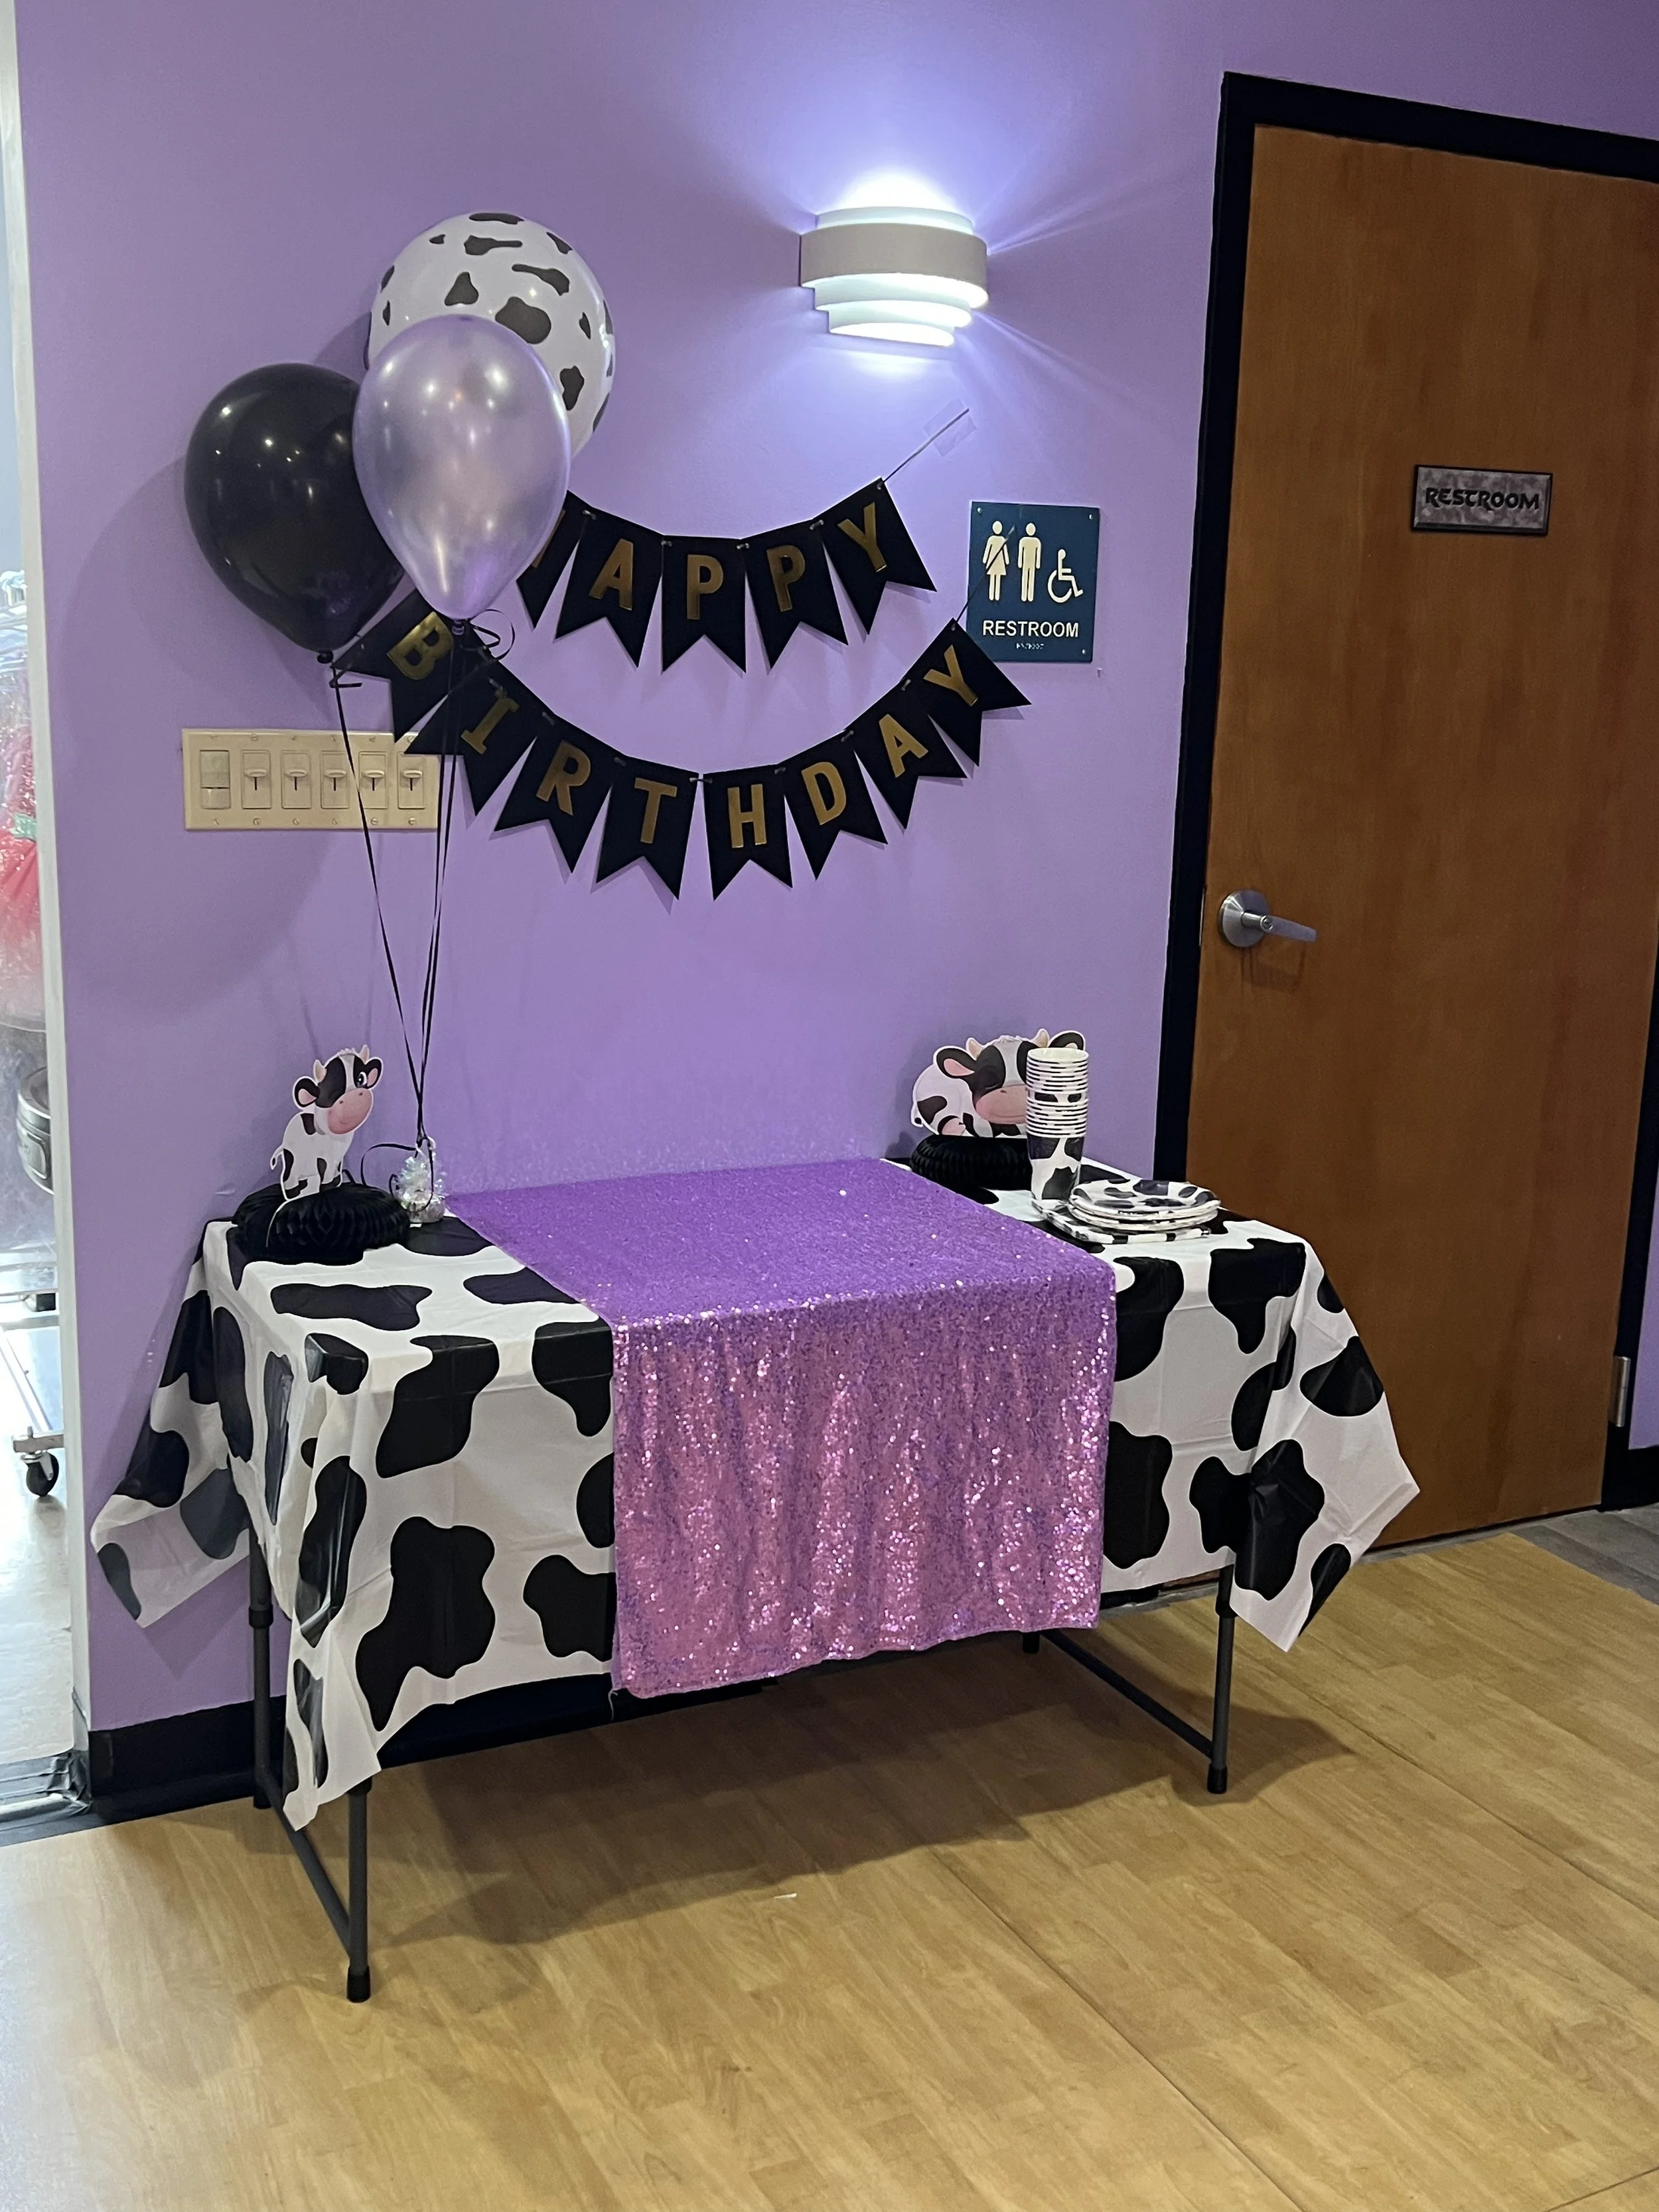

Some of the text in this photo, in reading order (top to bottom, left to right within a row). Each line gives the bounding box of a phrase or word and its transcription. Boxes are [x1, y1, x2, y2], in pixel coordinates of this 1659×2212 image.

[1425, 486, 1540, 511] RESTROOM
[532, 502, 888, 621] APPY
[982, 619, 1079, 638] RESTROOM
[387, 611, 978, 849] BIRTHDAY
